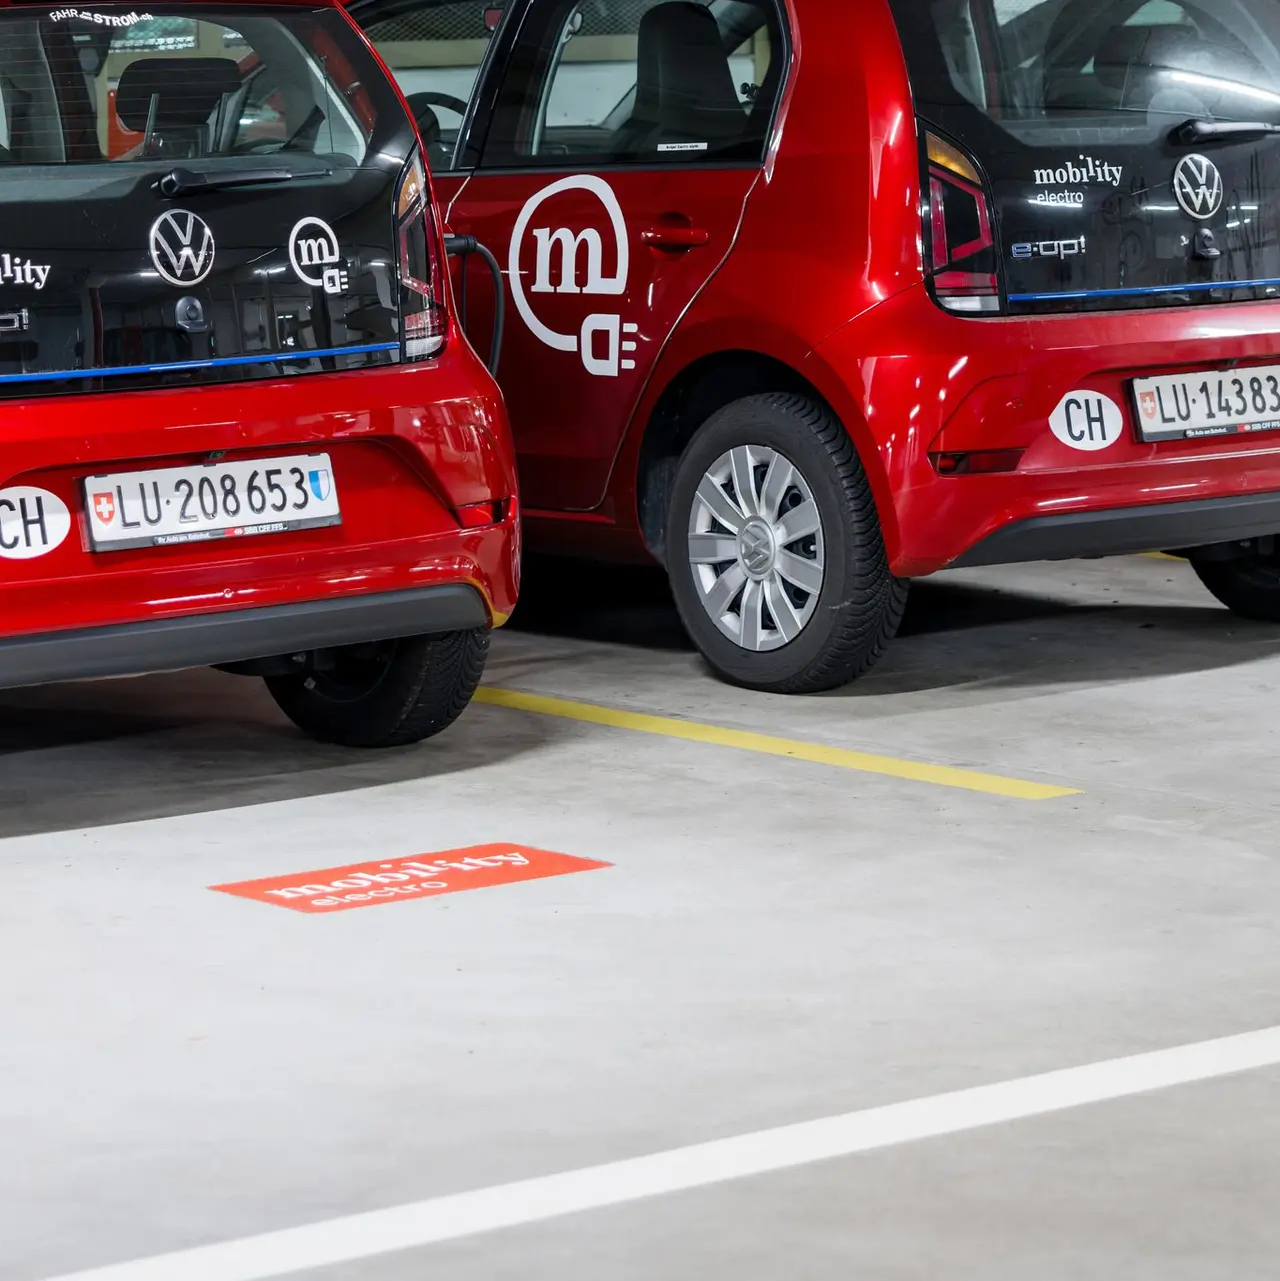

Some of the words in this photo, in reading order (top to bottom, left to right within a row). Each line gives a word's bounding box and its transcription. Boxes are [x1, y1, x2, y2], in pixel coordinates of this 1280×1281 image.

[49, 8, 79, 22] FAHR
[1033, 154, 1123, 187] mobility
[1036, 189, 1084, 204] electro
[1064, 398, 1107, 442] CH
[264, 851, 531, 899] mobility
[311, 880, 449, 907] electro
